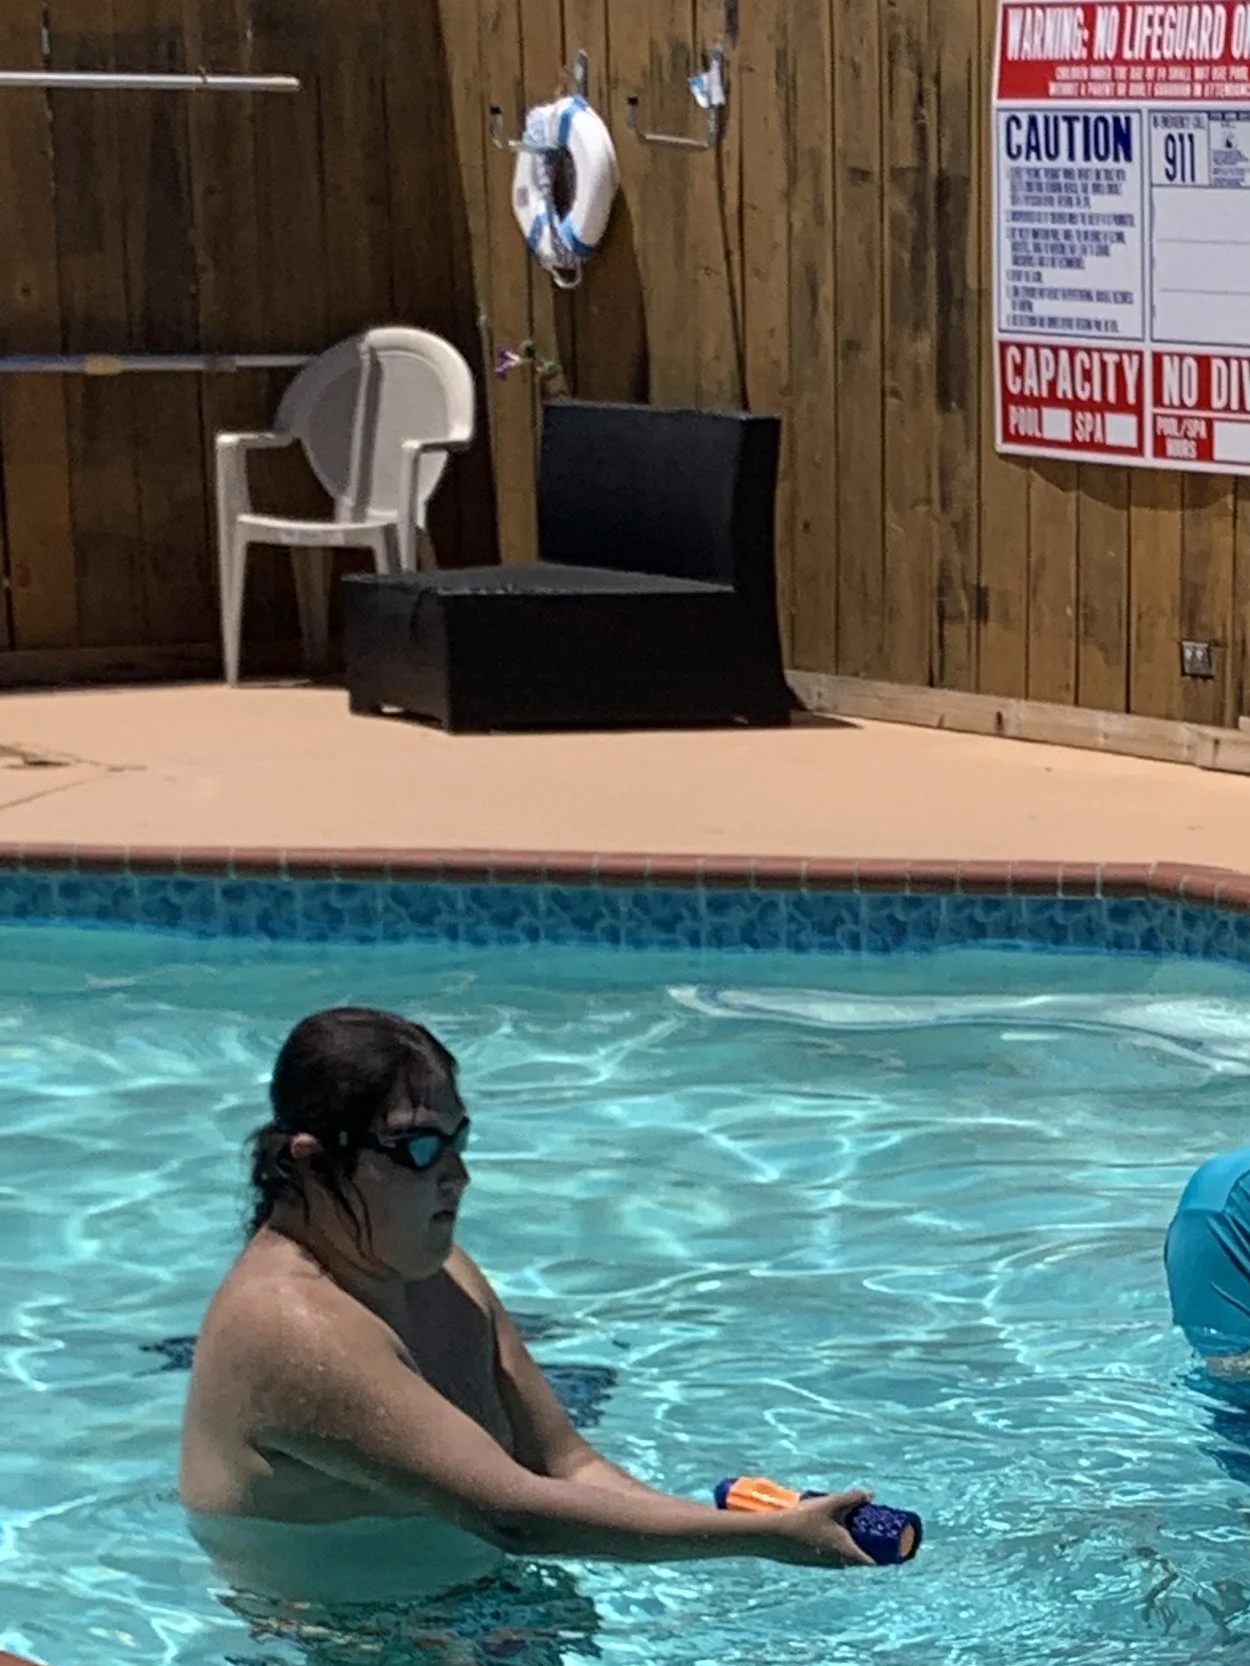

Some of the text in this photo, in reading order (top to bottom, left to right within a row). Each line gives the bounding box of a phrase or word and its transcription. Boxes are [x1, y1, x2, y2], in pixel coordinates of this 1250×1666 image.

[1007, 6, 1089, 61] WARNING:
[1093, 5, 1120, 60] NO
[1122, 3, 1227, 60] LIFEGUARD
[1005, 114, 1133, 162] CAUTION
[1164, 133, 1196, 182] 911
[1005, 345, 1140, 405] CAPACITY
[1162, 355, 1198, 407] NO
[1008, 404, 1104, 443] POOL SPA
